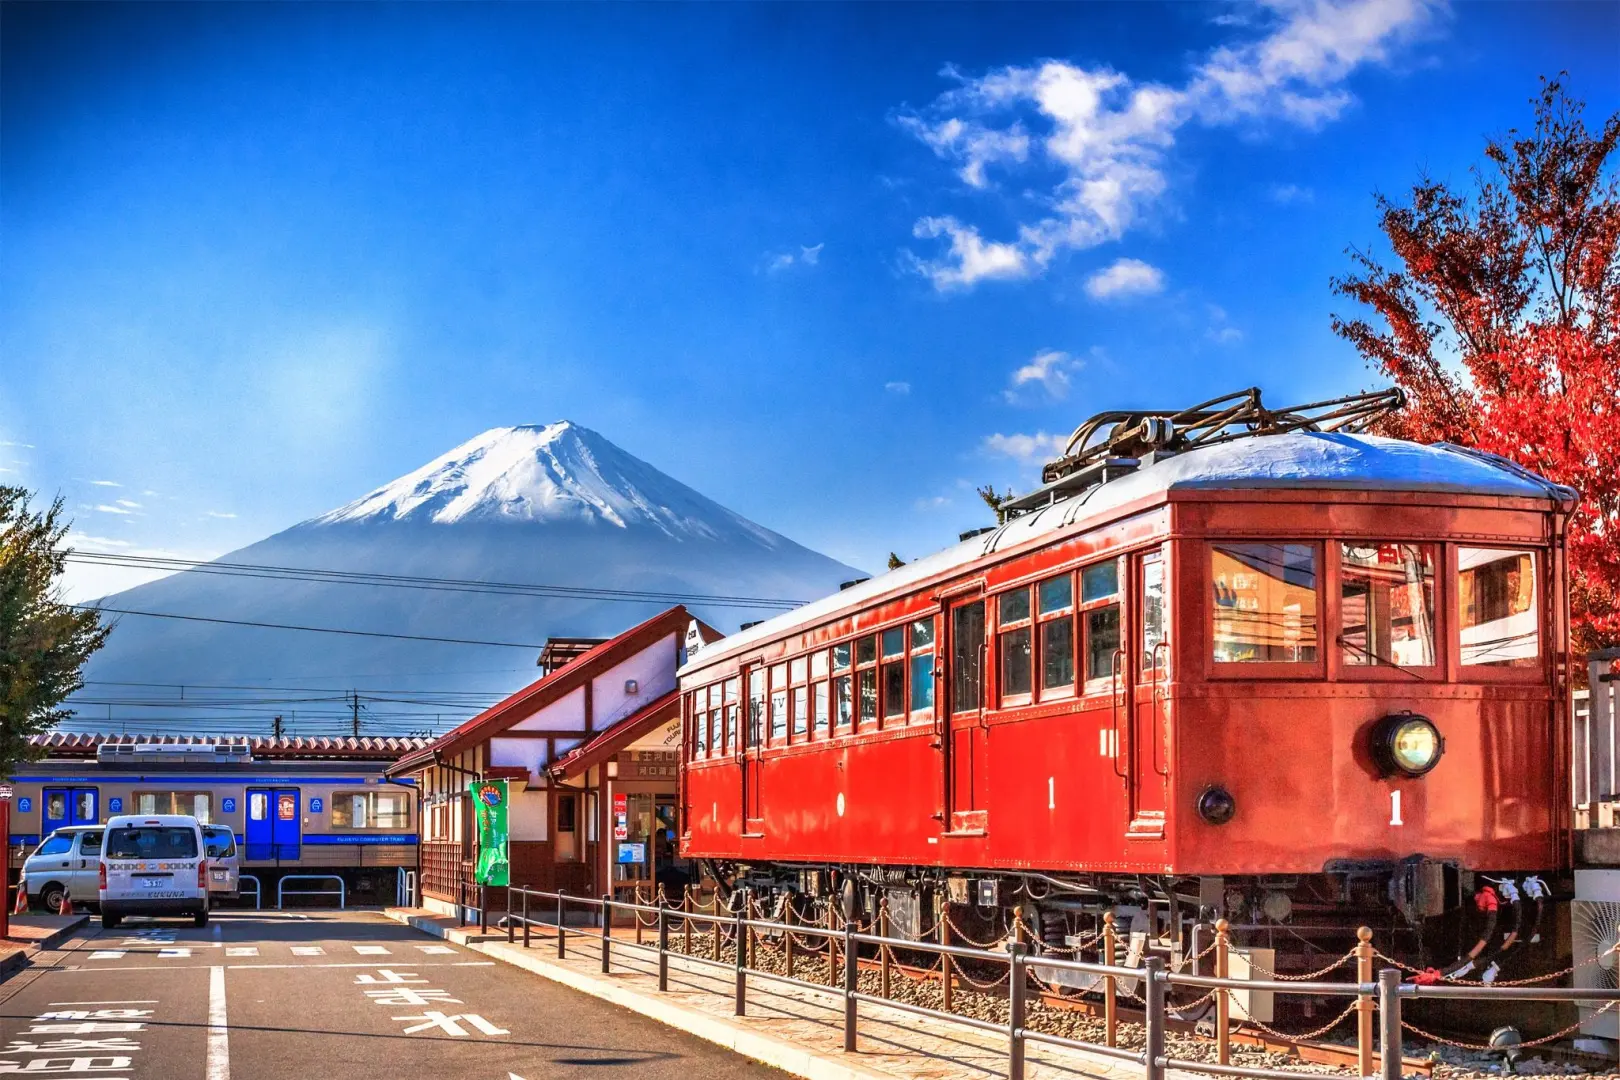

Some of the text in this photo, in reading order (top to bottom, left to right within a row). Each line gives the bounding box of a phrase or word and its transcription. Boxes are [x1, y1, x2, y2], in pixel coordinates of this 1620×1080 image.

[663, 728, 681, 746] TOURI
[1048, 776, 1055, 809] 1
[1389, 789, 1403, 826] 1
[353, 969, 511, 1037] 止まれ
[0, 1000, 160, 1080] 一般車送迎
